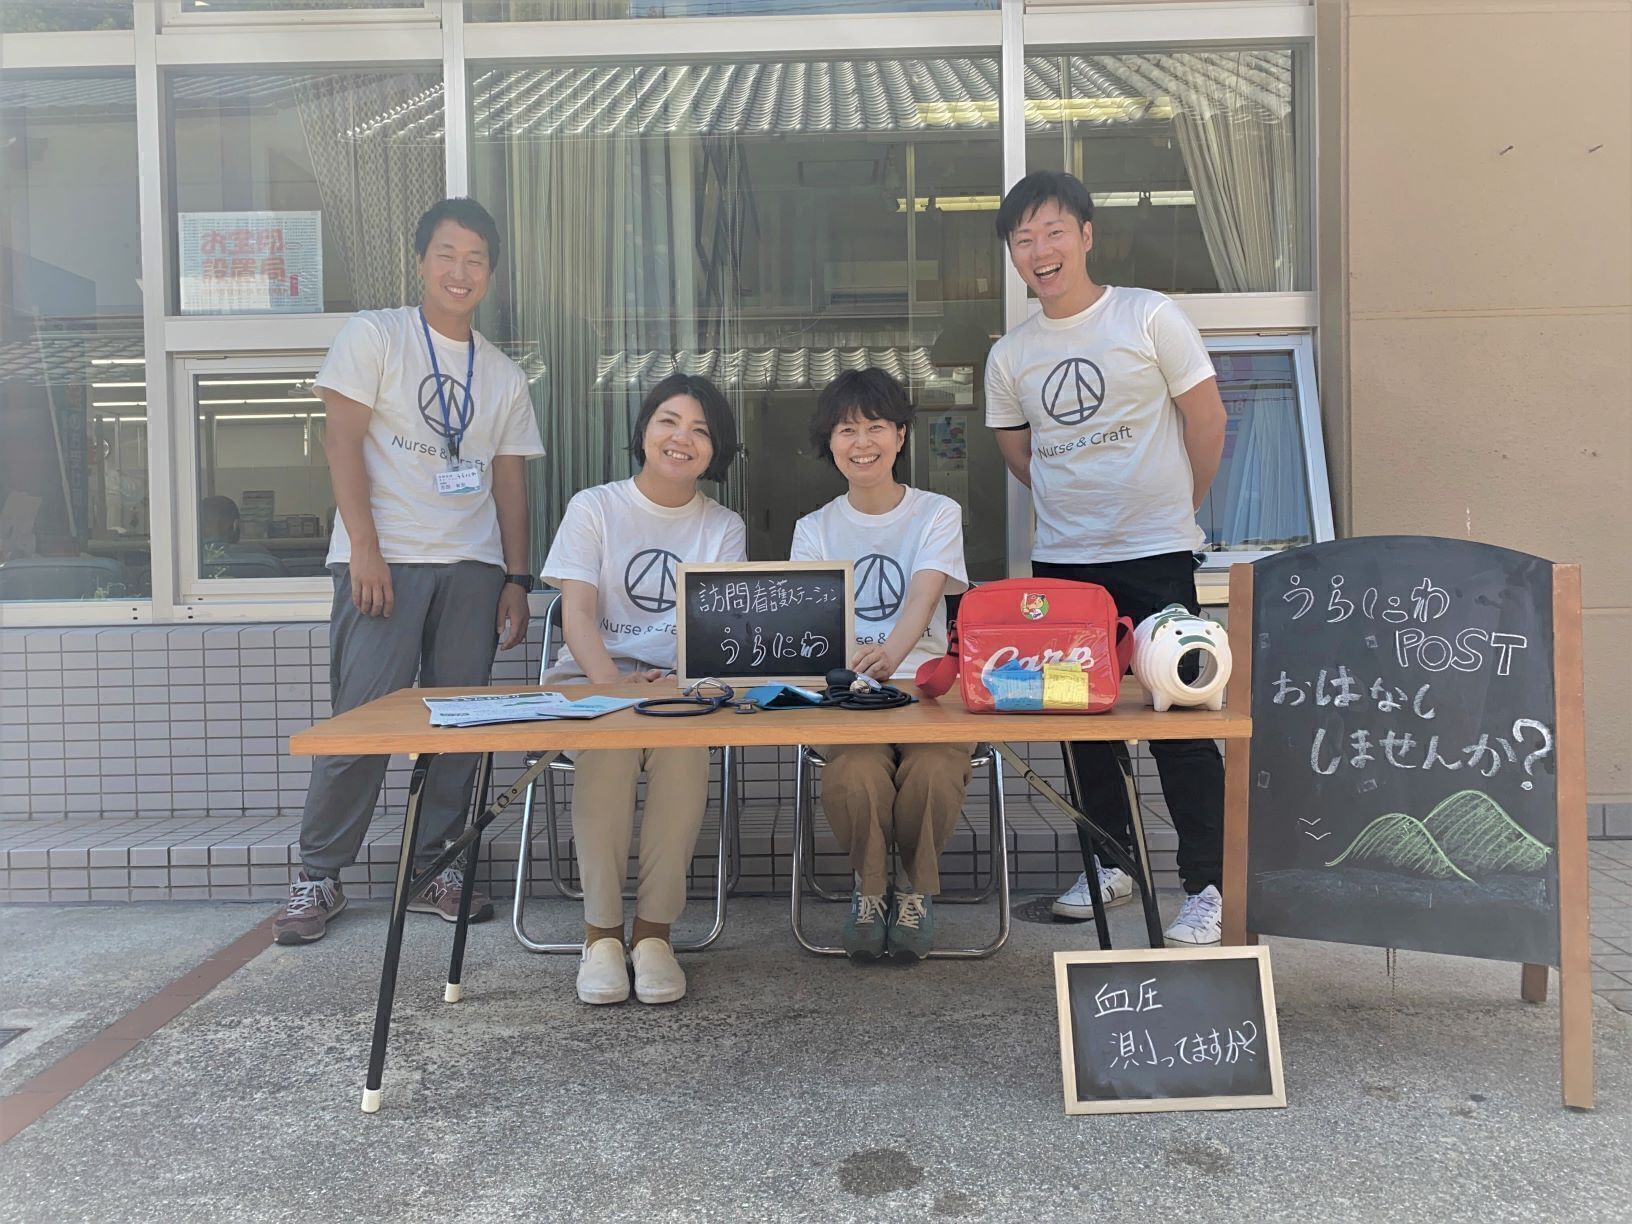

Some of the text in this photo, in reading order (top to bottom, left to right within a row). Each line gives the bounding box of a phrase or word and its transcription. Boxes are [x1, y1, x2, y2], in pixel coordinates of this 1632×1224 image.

[391, 435, 437, 456] Nurse
[1038, 425, 1132, 460] Nurse & Craft
[698, 579, 838, 613] 訪問看護ステーション
[1282, 574, 1450, 623] うらにわ
[599, 617, 642, 636] Nurse
[720, 626, 829, 666] うらにわ
[981, 646, 1094, 689] Carp
[1395, 627, 1527, 675] POST
[1271, 665, 1435, 719] おはなし
[1094, 978, 1163, 1018] 血圧
